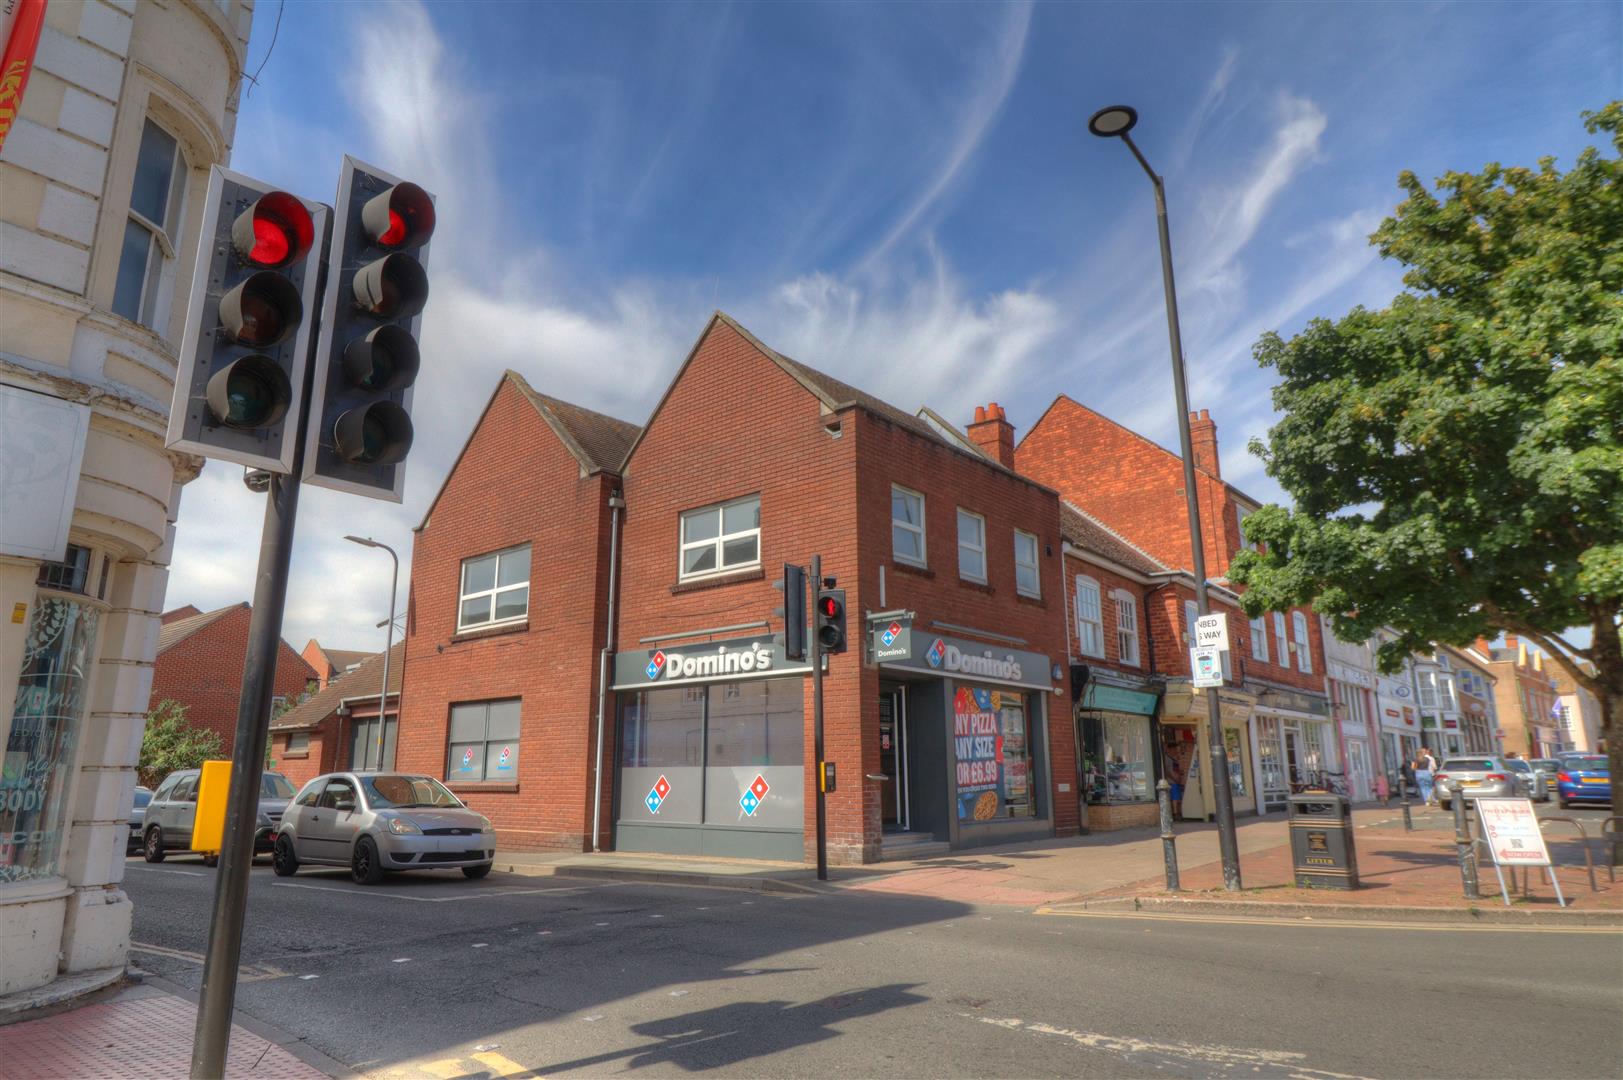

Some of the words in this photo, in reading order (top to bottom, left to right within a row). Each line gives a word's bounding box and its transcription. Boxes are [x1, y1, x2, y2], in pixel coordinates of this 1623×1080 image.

[1198, 619, 1217, 628] NBED
[1204, 630, 1221, 640] WAY
[666, 642, 772, 678] Domino's
[878, 647, 907, 657] Domino's
[944, 644, 1022, 681] Domino's
[955, 713, 969, 735] NY
[971, 713, 997, 734] PIZZA
[975, 736, 995, 757] SIZE
[956, 762, 969, 785] OR
[971, 761, 997, 783] £6.99
